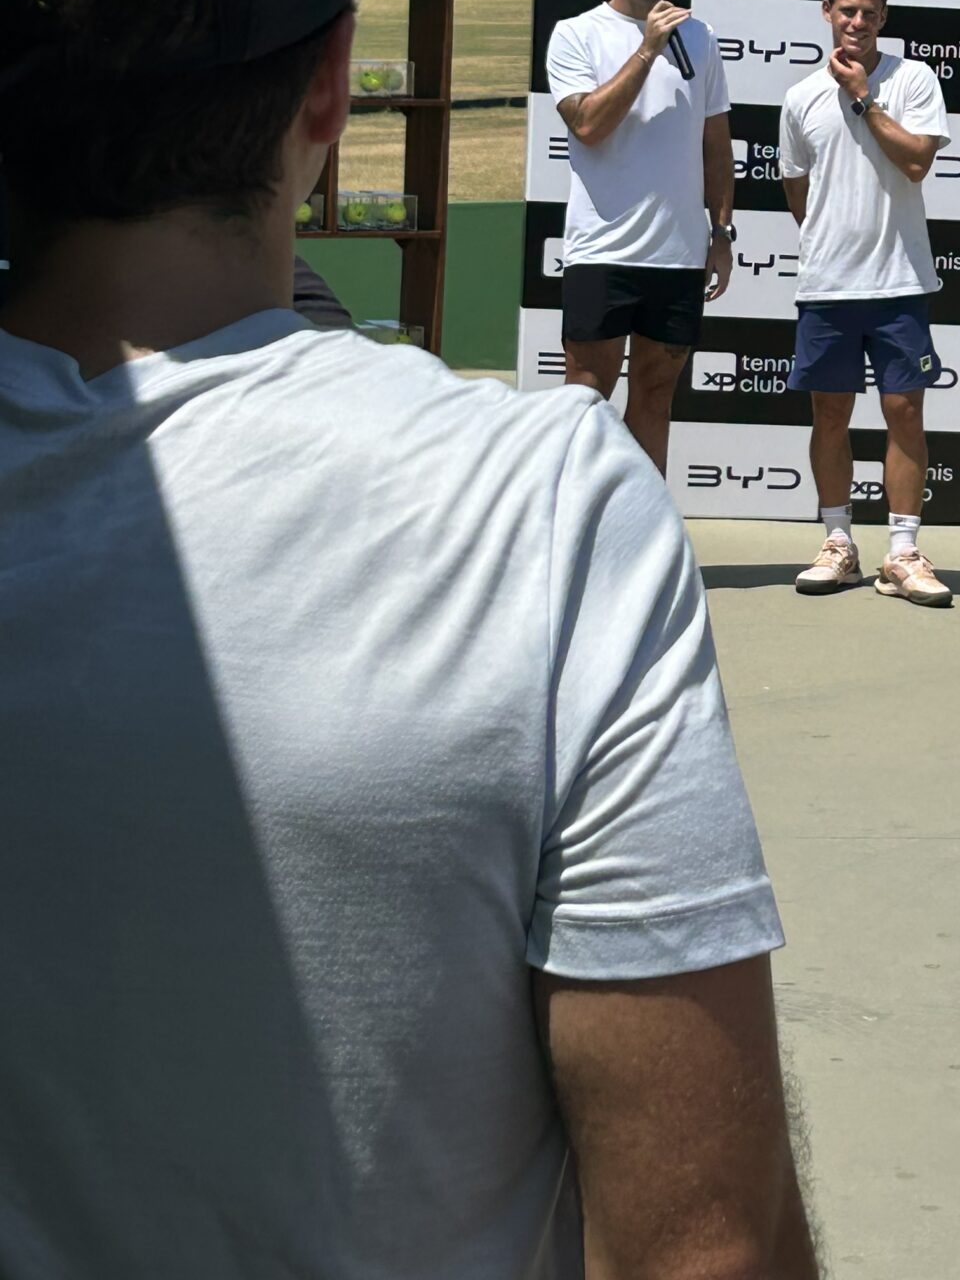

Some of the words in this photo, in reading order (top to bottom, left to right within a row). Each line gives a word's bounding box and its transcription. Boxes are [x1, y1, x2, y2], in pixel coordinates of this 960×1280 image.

[717, 38, 824, 65] BYD
[751, 162, 783, 180] clu
[741, 355, 796, 373] tenni
[740, 375, 786, 394] club
[688, 465, 801, 489] BYD
[926, 463, 953, 481] nis
